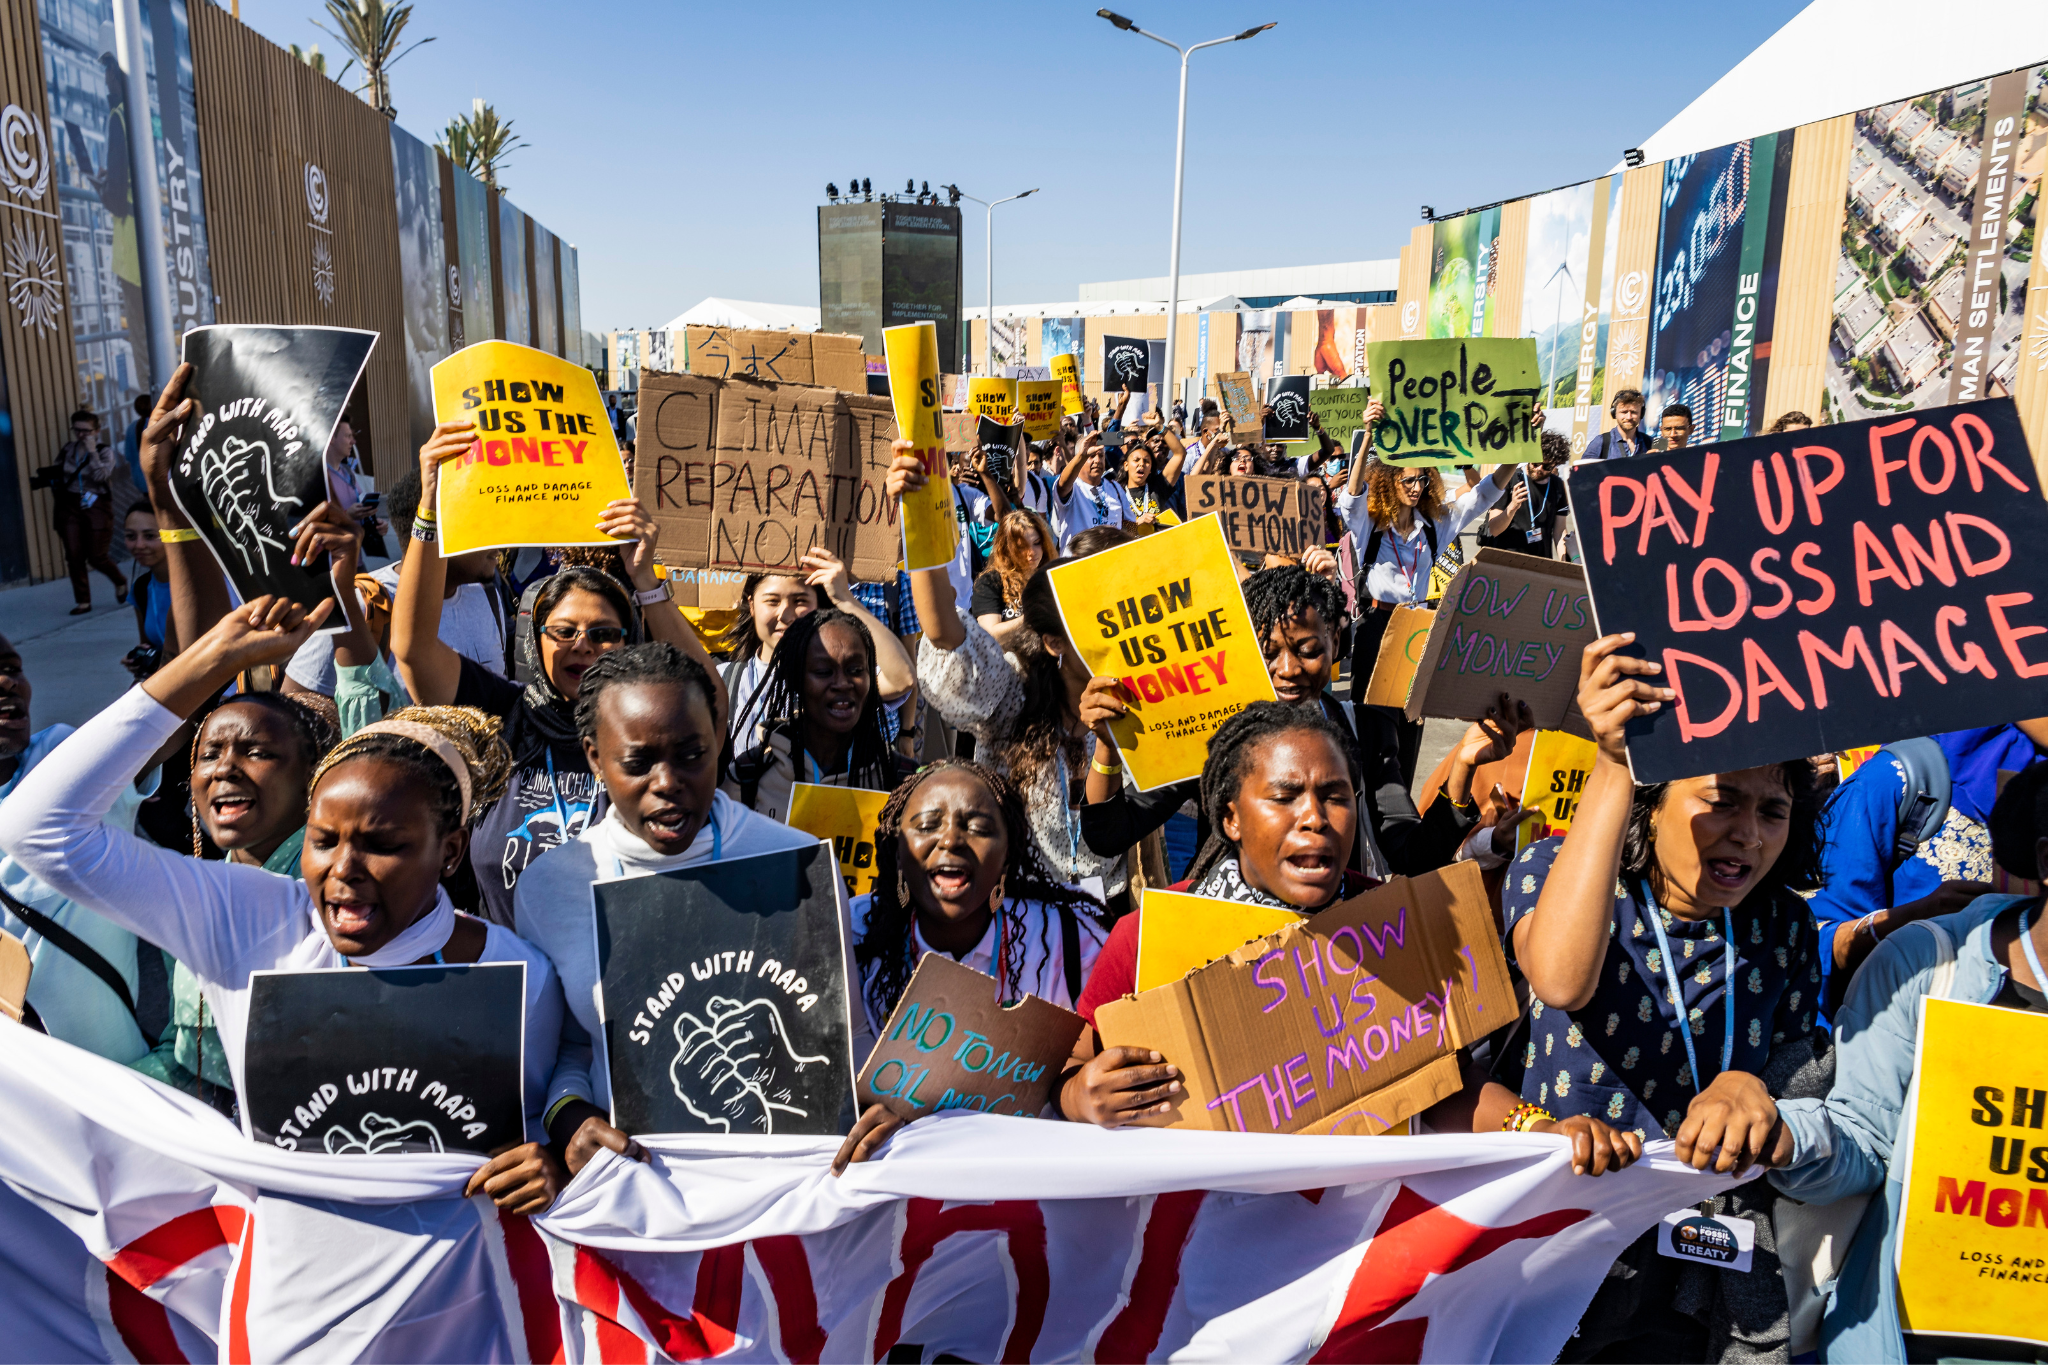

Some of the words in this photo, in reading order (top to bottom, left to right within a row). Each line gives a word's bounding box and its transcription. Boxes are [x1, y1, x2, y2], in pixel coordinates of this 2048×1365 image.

[1967, 116, 2015, 330] SETTLEMENTS
[892, 303, 927, 311] TOGETHER
[1471, 242, 1490, 338] ERSITY
[697, 330, 799, 380] 今すぐ
[1017, 368, 1043, 381] PAY
[1575, 301, 1598, 422] ENERGY
[1724, 272, 1760, 428] FINANCE
[1960, 336, 1983, 404] MAN
[462, 379, 564, 410] SHOW
[976, 393, 1006, 404] SHOW
[1026, 392, 1052, 402] SHOW
[1310, 393, 1362, 406] COUNTRIES
[1389, 342, 1497, 413] People
[478, 408, 527, 434] US
[533, 408, 597, 435] THE
[655, 391, 893, 471] CLIMATE
[980, 404, 992, 415] US
[995, 404, 1014, 416] THE
[1023, 411, 1054, 422] MONEY
[1030, 403, 1040, 412] US
[1042, 401, 1058, 411] THE
[1374, 405, 1474, 458] OVER
[179, 412, 216, 478] STAND
[219, 397, 267, 423] WITH
[262, 407, 303, 458] MAPA
[455, 436, 589, 471] MONEY
[479, 484, 510, 495] LOSS
[515, 483, 538, 492] AND
[543, 481, 593, 492] DAMAGE
[495, 492, 548, 504] FINANCE
[553, 493, 579, 502] NOW
[1198, 480, 1288, 516] SHOW
[1298, 487, 1322, 522] US
[1599, 452, 1720, 565] PAY
[1752, 445, 1846, 535] UP
[1869, 413, 2030, 506] FOR
[1665, 541, 1837, 632] LOSS
[1853, 511, 2011, 606] AND
[1095, 576, 1194, 639] SHOW
[1542, 588, 1590, 631] US
[1118, 633, 1168, 668] US
[1168, 607, 1232, 653] THE
[1438, 621, 1566, 682] MONEY
[1110, 650, 1228, 705] MONEY
[1662, 592, 2048, 743] DAMAGE
[1149, 718, 1175, 732] LOSS
[1177, 713, 1197, 728] AND
[1200, 702, 1243, 722] DAMAGE
[1165, 722, 1208, 740] FINANCE
[1251, 906, 1407, 1014] SHOW
[629, 972, 686, 1047] STAND
[690, 950, 754, 982] WITH
[757, 958, 819, 1013] MAPA
[1312, 974, 1379, 1038] US
[888, 1002, 956, 1053] NO
[870, 1058, 931, 1110] OIL
[1206, 1051, 1318, 1133] THE
[274, 1083, 339, 1153] STAND
[346, 1067, 419, 1096] WITH
[420, 1080, 488, 1141] MAPA
[1680, 1244, 1730, 1260] TREATY
[1700, 1228, 1730, 1240] FOSSIL
[1700, 1236, 1730, 1248] FUEL
[1960, 1250, 2004, 1266] LOSS
[2011, 1256, 2046, 1270] AND
[1978, 1266, 2048, 1283] FINANC
